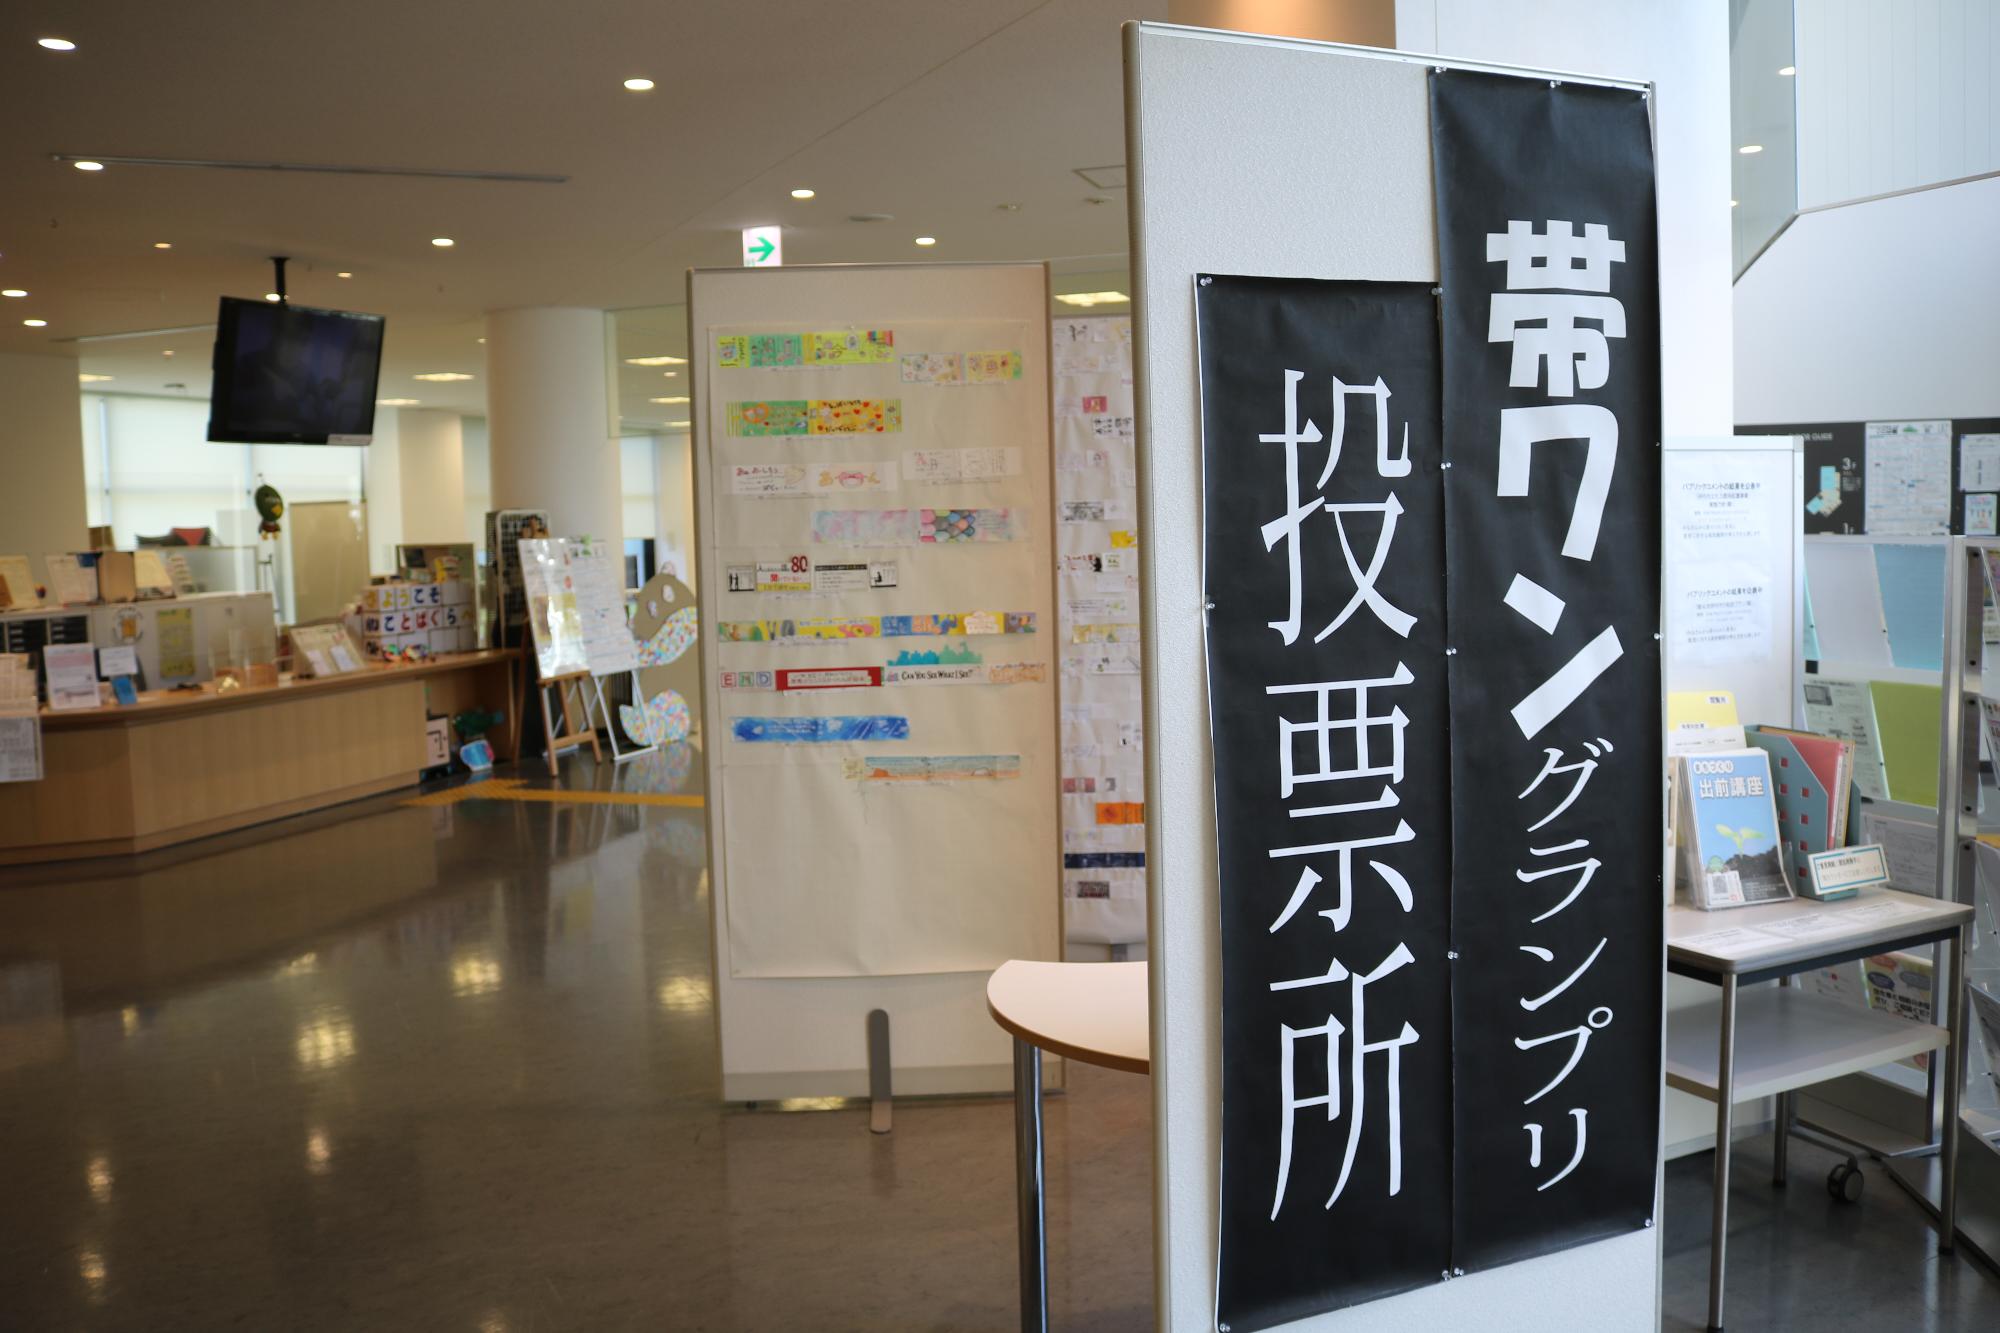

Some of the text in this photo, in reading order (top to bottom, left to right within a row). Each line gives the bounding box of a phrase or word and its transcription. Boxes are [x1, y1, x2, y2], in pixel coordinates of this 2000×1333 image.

[1258, 368, 1420, 1222] 投票所
[1487, 220, 1626, 1191] 帯ワングランプリ
[1700, 776, 1764, 798] 出前講座
